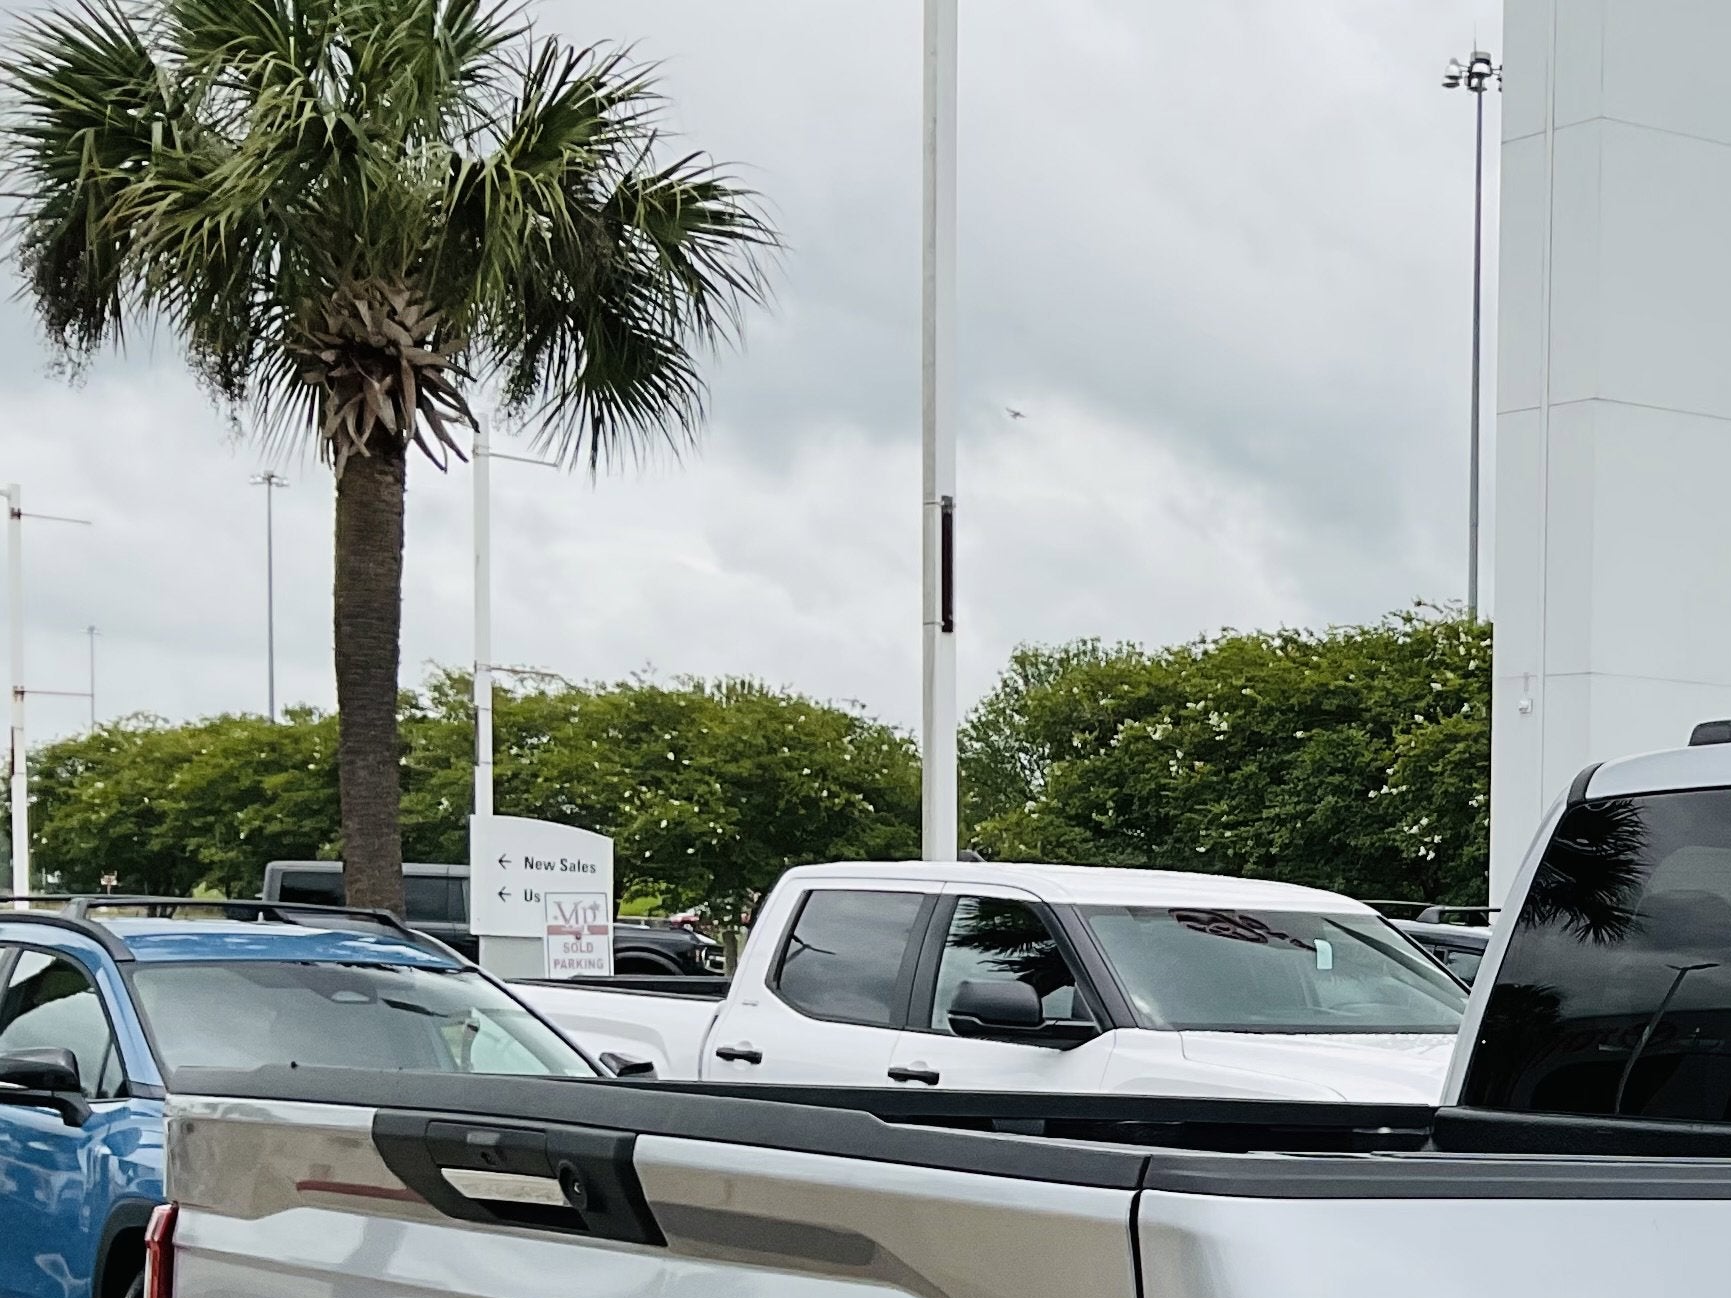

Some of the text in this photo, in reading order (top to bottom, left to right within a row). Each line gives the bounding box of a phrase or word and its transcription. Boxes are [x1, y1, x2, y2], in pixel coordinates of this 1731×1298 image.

[524, 856, 597, 874] New Sales
[523, 889, 541, 903] Us
[563, 942, 594, 954] SOLD
[553, 958, 604, 970] PARKING
